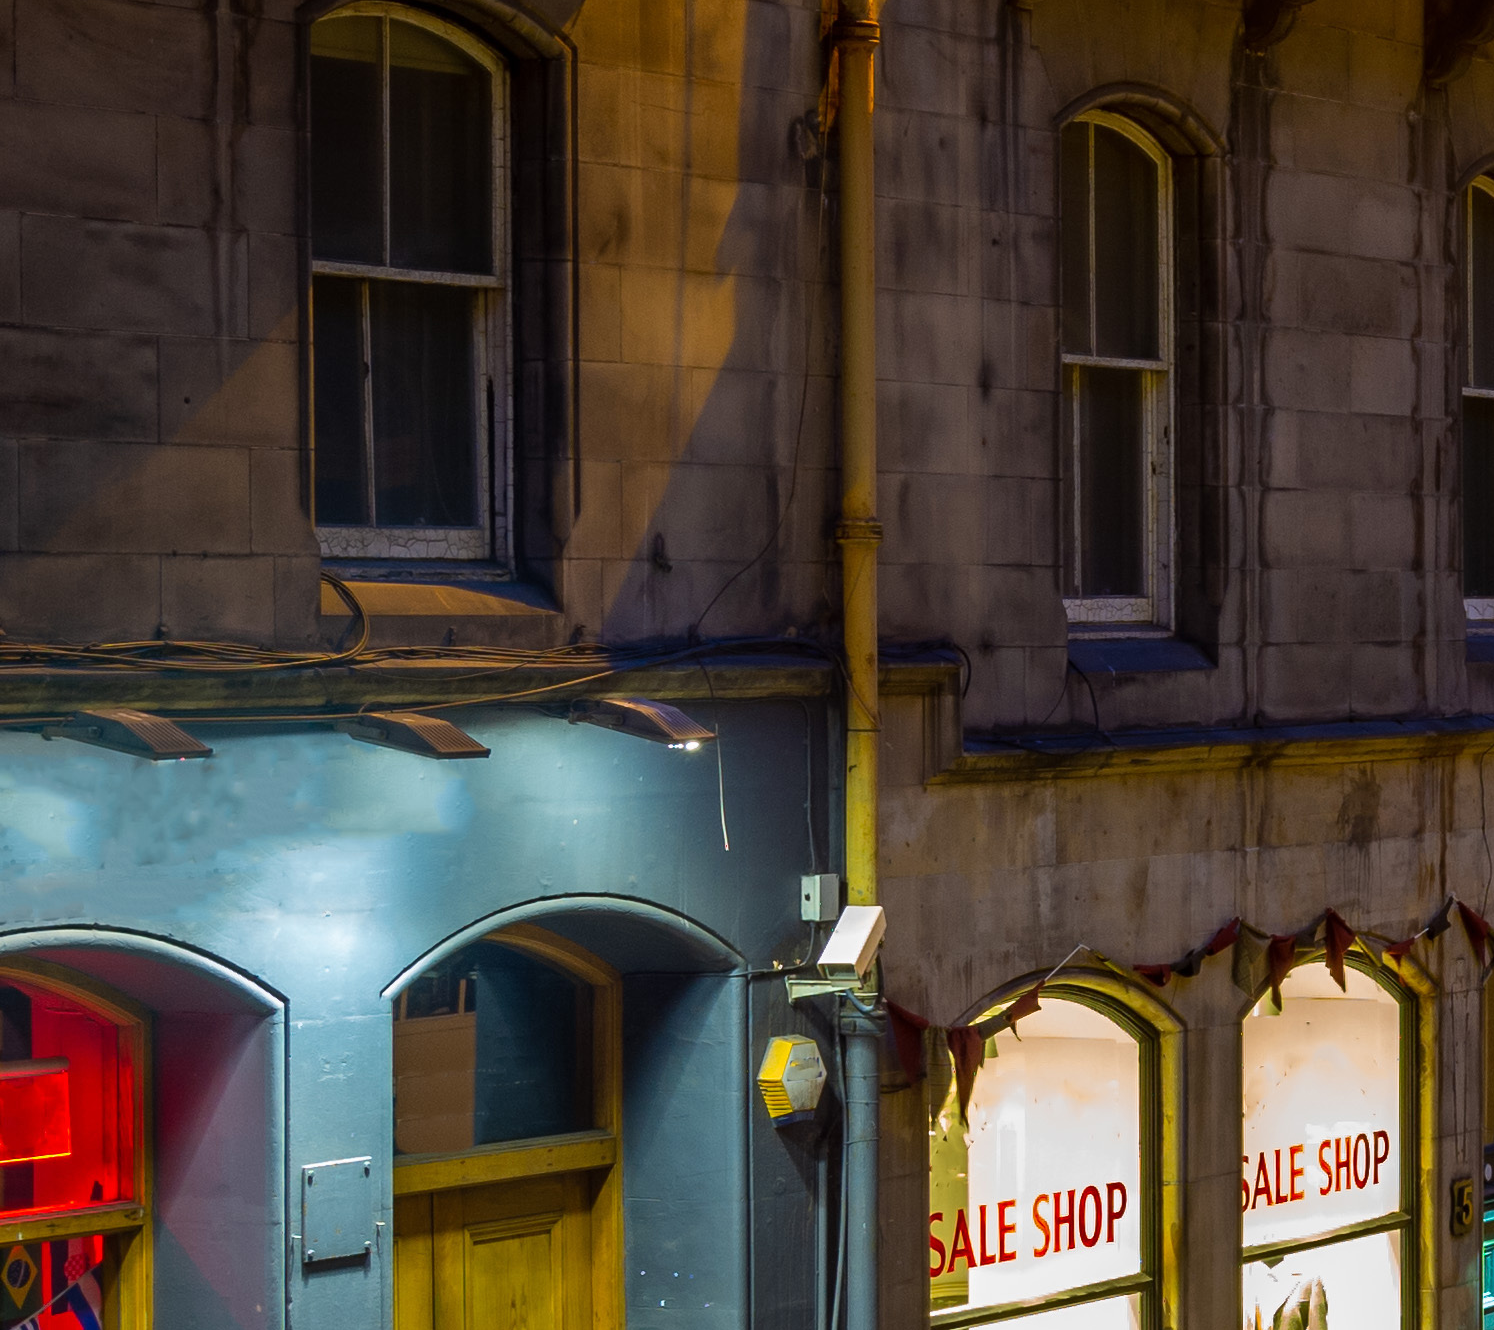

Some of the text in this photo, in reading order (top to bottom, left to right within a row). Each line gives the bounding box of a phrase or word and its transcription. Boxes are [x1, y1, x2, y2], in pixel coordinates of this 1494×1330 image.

[1318, 1130, 1390, 1196] SHOP
[929, 1182, 1127, 1278] SALE SHOP
[1460, 1183, 1474, 1225] 5
